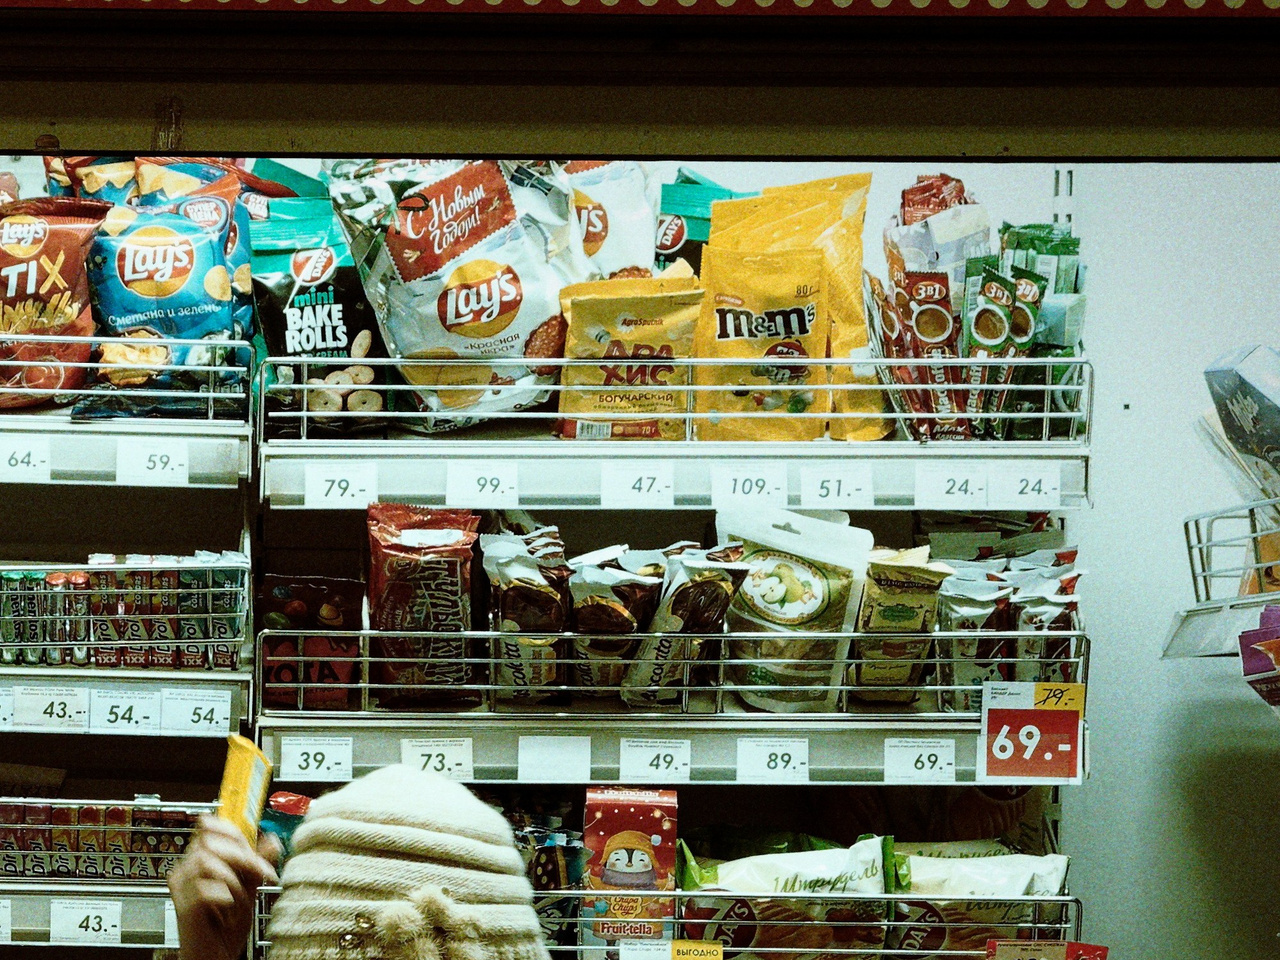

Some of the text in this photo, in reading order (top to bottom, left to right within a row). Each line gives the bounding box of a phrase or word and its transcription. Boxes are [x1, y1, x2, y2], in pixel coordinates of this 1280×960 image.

[429, 182, 485, 232] Новым
[1, 223, 44, 246] Lay's
[430, 209, 482, 255] Годом!
[123, 242, 193, 282] Lay's
[293, 286, 334, 306] mini
[446, 268, 521, 326] Lay's
[107, 302, 223, 327] Сметана и зелень
[286, 303, 344, 330] BAKE
[622, 317, 664, 327] AgroSputnik
[715, 304, 816, 340] m&m's
[285, 328, 349, 354] ROLLS
[598, 363, 675, 387] ХИС
[598, 392, 675, 405] БОГУЧАРСКИЙ
[146, 454, 185, 471] 59.-
[324, 478, 367, 498] 79.-
[477, 477, 516, 494] 99.-
[632, 477, 672, 495] 47.-
[730, 477, 782, 496] 109.-
[944, 478, 985, 496] 24.-
[191, 706, 229, 726] 54.-
[991, 724, 1071, 761] 69.-
[297, 752, 342, 771] 39.-
[420, 753, 463, 773] 73.-
[648, 753, 689, 771] 49.-
[913, 754, 953, 771] 69.-
[78, 916, 118, 933] 43.-
[600, 923, 653, 936] Fruit-tella
[676, 948, 719, 957] ВЫГОДНО
